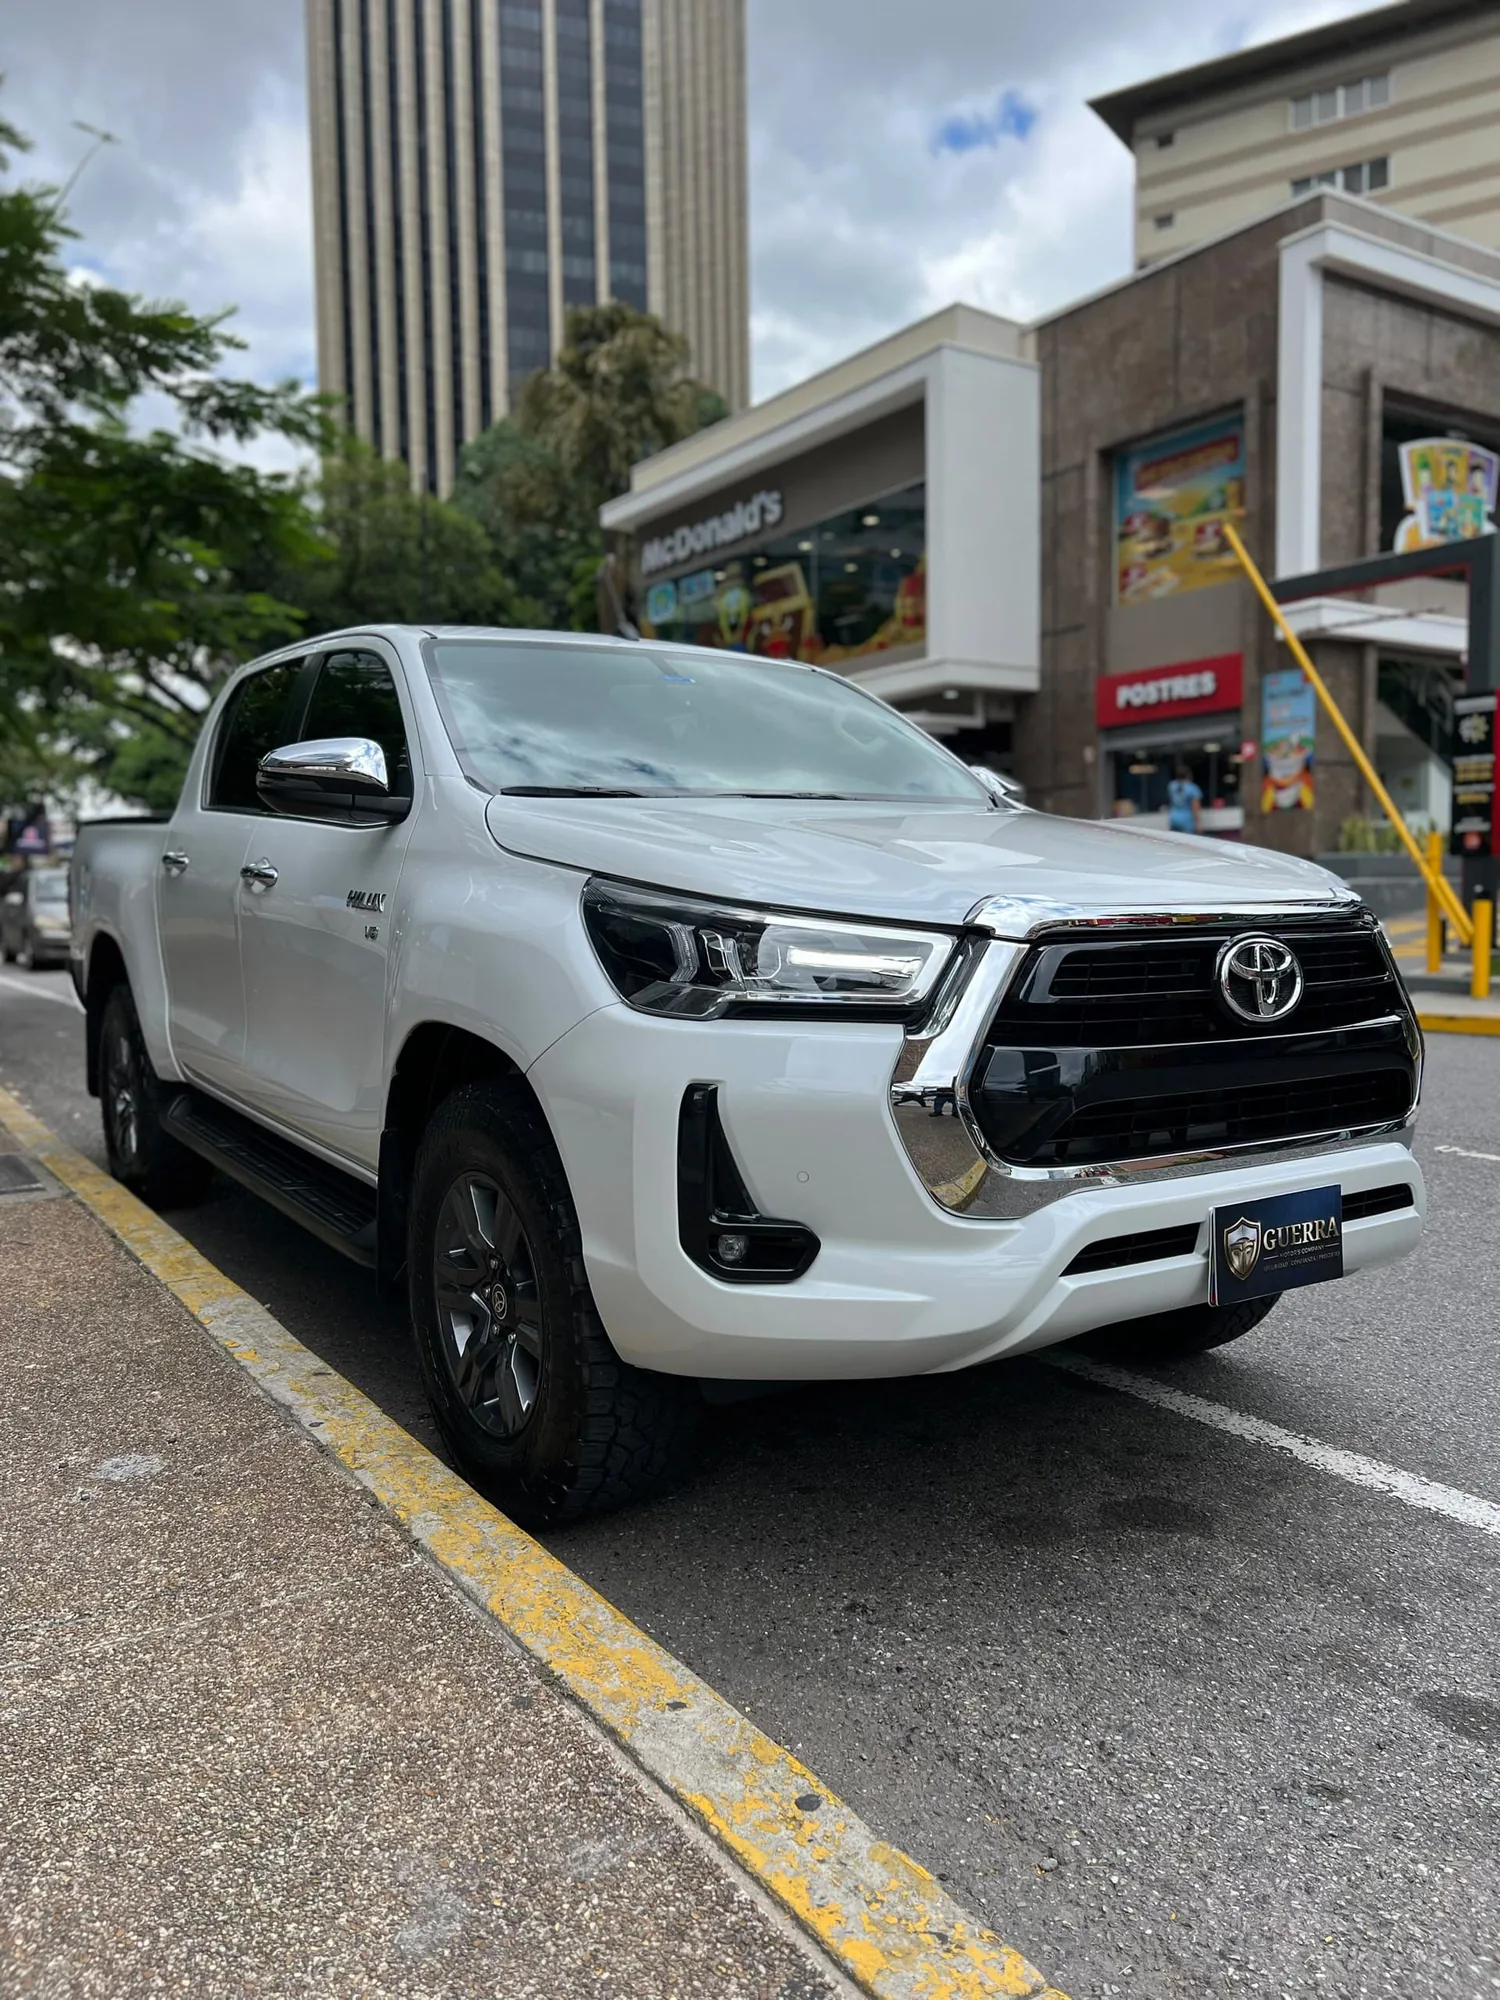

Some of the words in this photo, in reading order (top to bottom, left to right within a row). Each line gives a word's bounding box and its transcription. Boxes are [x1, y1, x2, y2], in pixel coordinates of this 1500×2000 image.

[642, 490, 782, 574] McDonald's
[1116, 671, 1215, 709] POSTRES
[346, 890, 387, 912] HILUX
[1264, 1216, 1339, 1250] GUERRA
[1301, 1244, 1325, 1255] COMPANY
